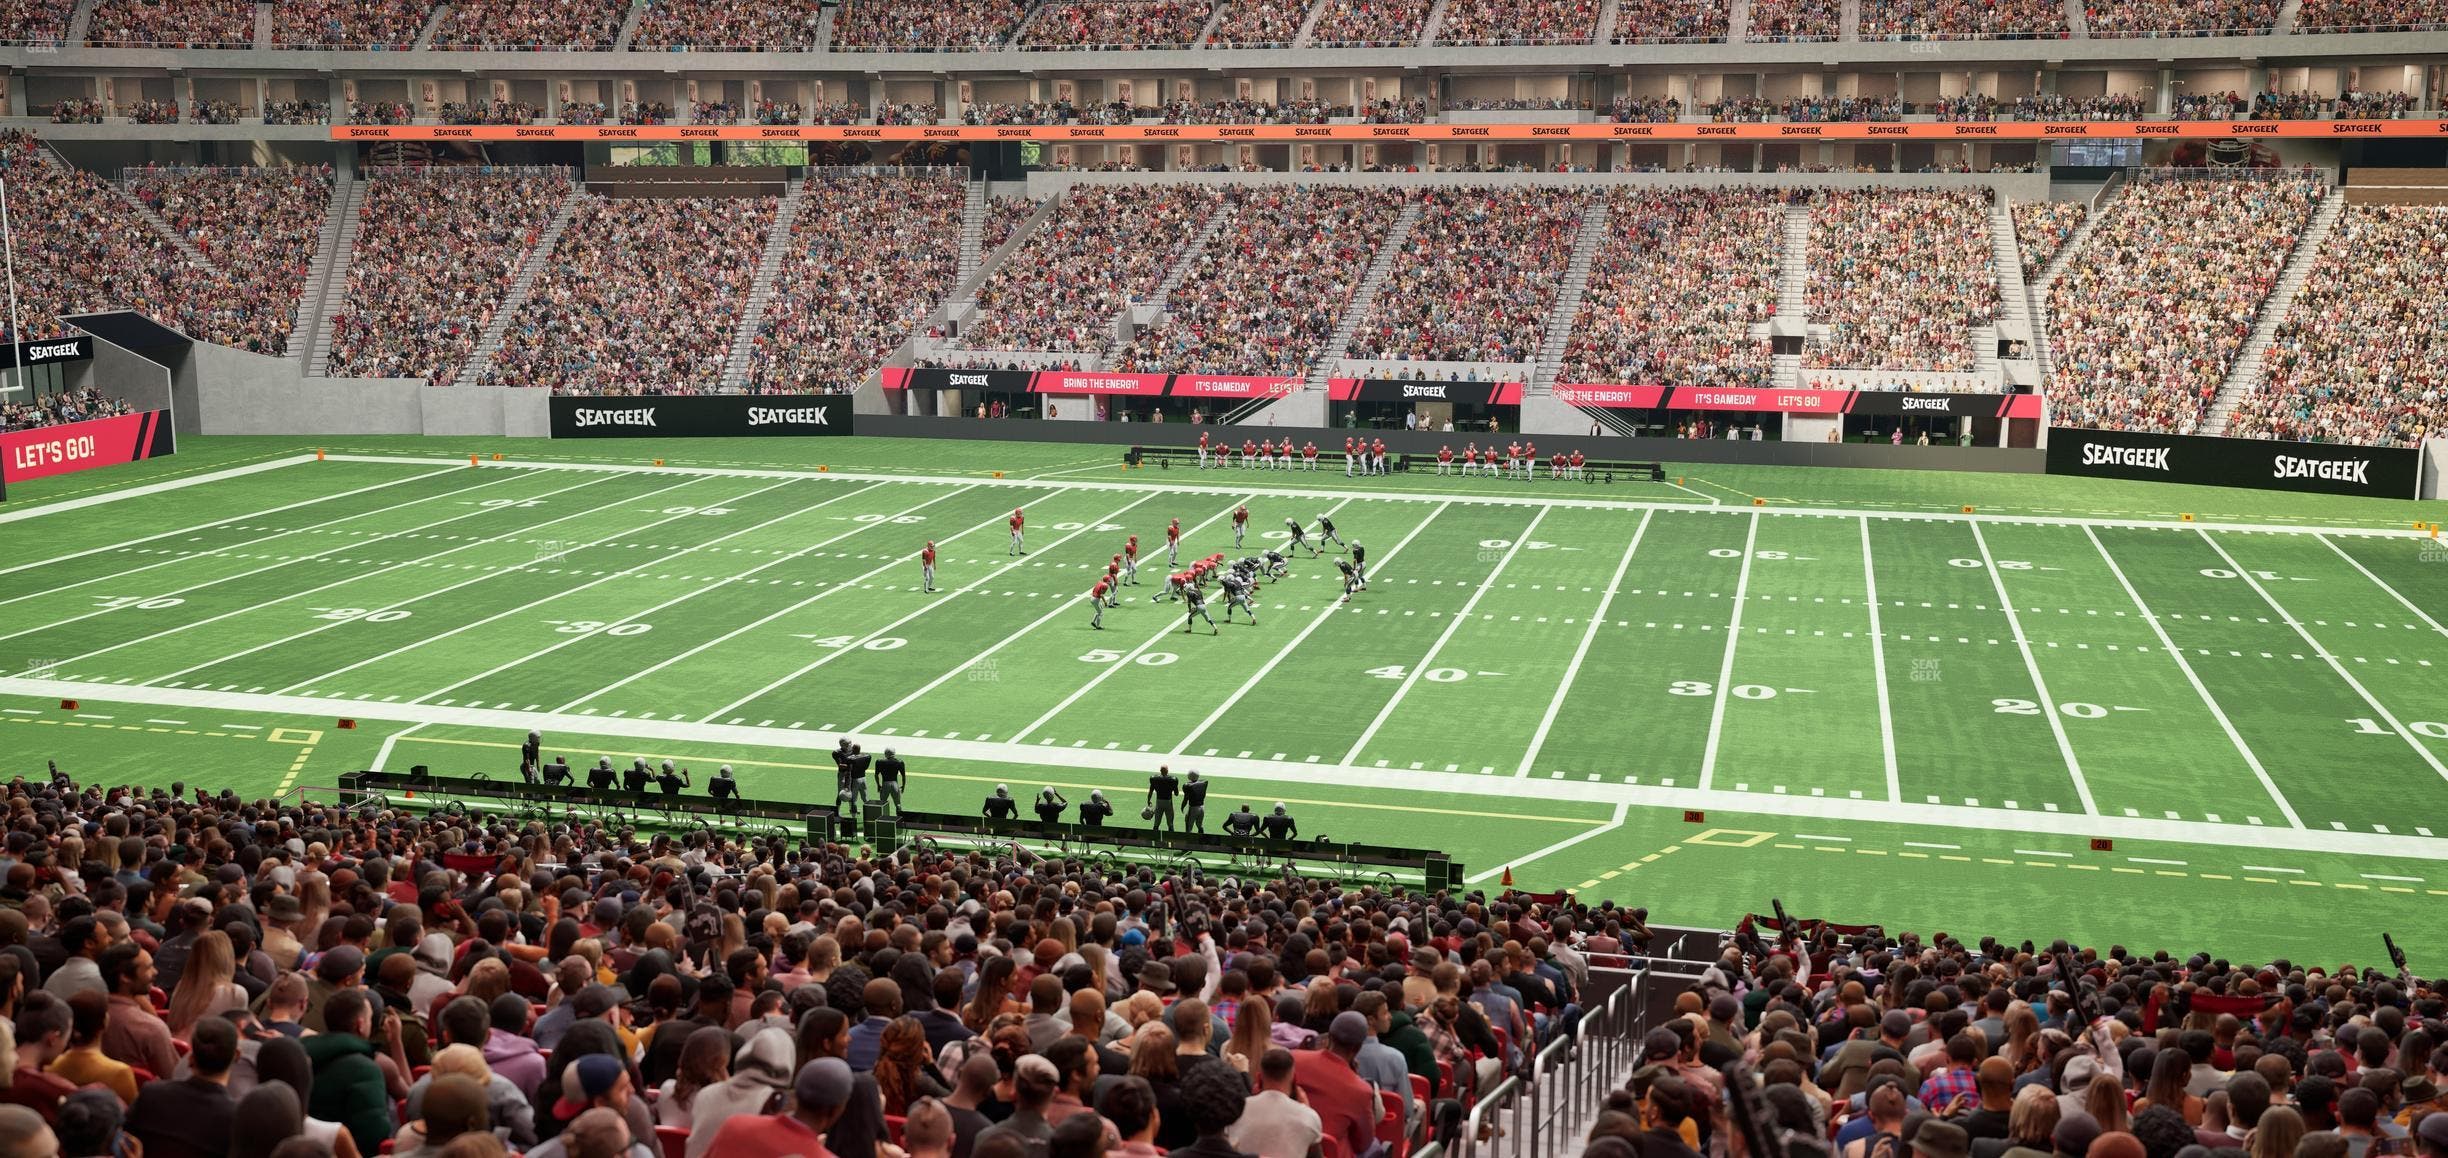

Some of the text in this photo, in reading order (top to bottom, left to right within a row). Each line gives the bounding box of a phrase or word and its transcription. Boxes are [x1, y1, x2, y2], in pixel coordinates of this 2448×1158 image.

[924, 129, 959, 137] SEATGEEK
[1144, 128, 1179, 136] SEATGEEK
[1219, 128, 1255, 136] SEATGEEK
[1614, 127, 1652, 135] SEATGEEK
[1697, 127, 1736, 135] SEATGEEK
[1782, 127, 1822, 135] SEATGEEK
[1868, 126, 1909, 134] SEATGEEK
[1956, 126, 1997, 134] SEATGEEK
[2045, 126, 2087, 134] SEATGEEK
[2136, 125, 2179, 134] SEATGEEK
[2232, 124, 2279, 134] SEATGEEK
[2333, 124, 2382, 133] SEATGEEK
[29, 341, 80, 361] SEATGEEK
[949, 373, 989, 387] SEATGEEK
[1063, 378, 1140, 390] BRING THE ENERGY!
[1195, 381, 1251, 392] IT'S GAMEDAY
[1403, 385, 1446, 399] SEATGEEK
[1577, 391, 1594, 401] THE
[1594, 391, 1632, 402] ENERGY!
[1695, 394, 1757, 405] IT'S GAMEDAY
[1778, 395, 1821, 407] LET'S GO!
[1902, 396, 1950, 411] SEATGEEK
[575, 407, 657, 427] SEATGEEK
[748, 406, 829, 426] SEATGEEK
[15, 435, 95, 469] LET'S GO!
[2082, 442, 2171, 471] SEATGEEK
[2274, 454, 2371, 485] SEATGEEK
[554, 621, 653, 635] 30
[811, 635, 908, 650] 40
[1077, 649, 1180, 665] 50
[1364, 665, 1468, 682] 40
[1668, 681, 1777, 700] 30
[1991, 699, 2108, 718] 20
